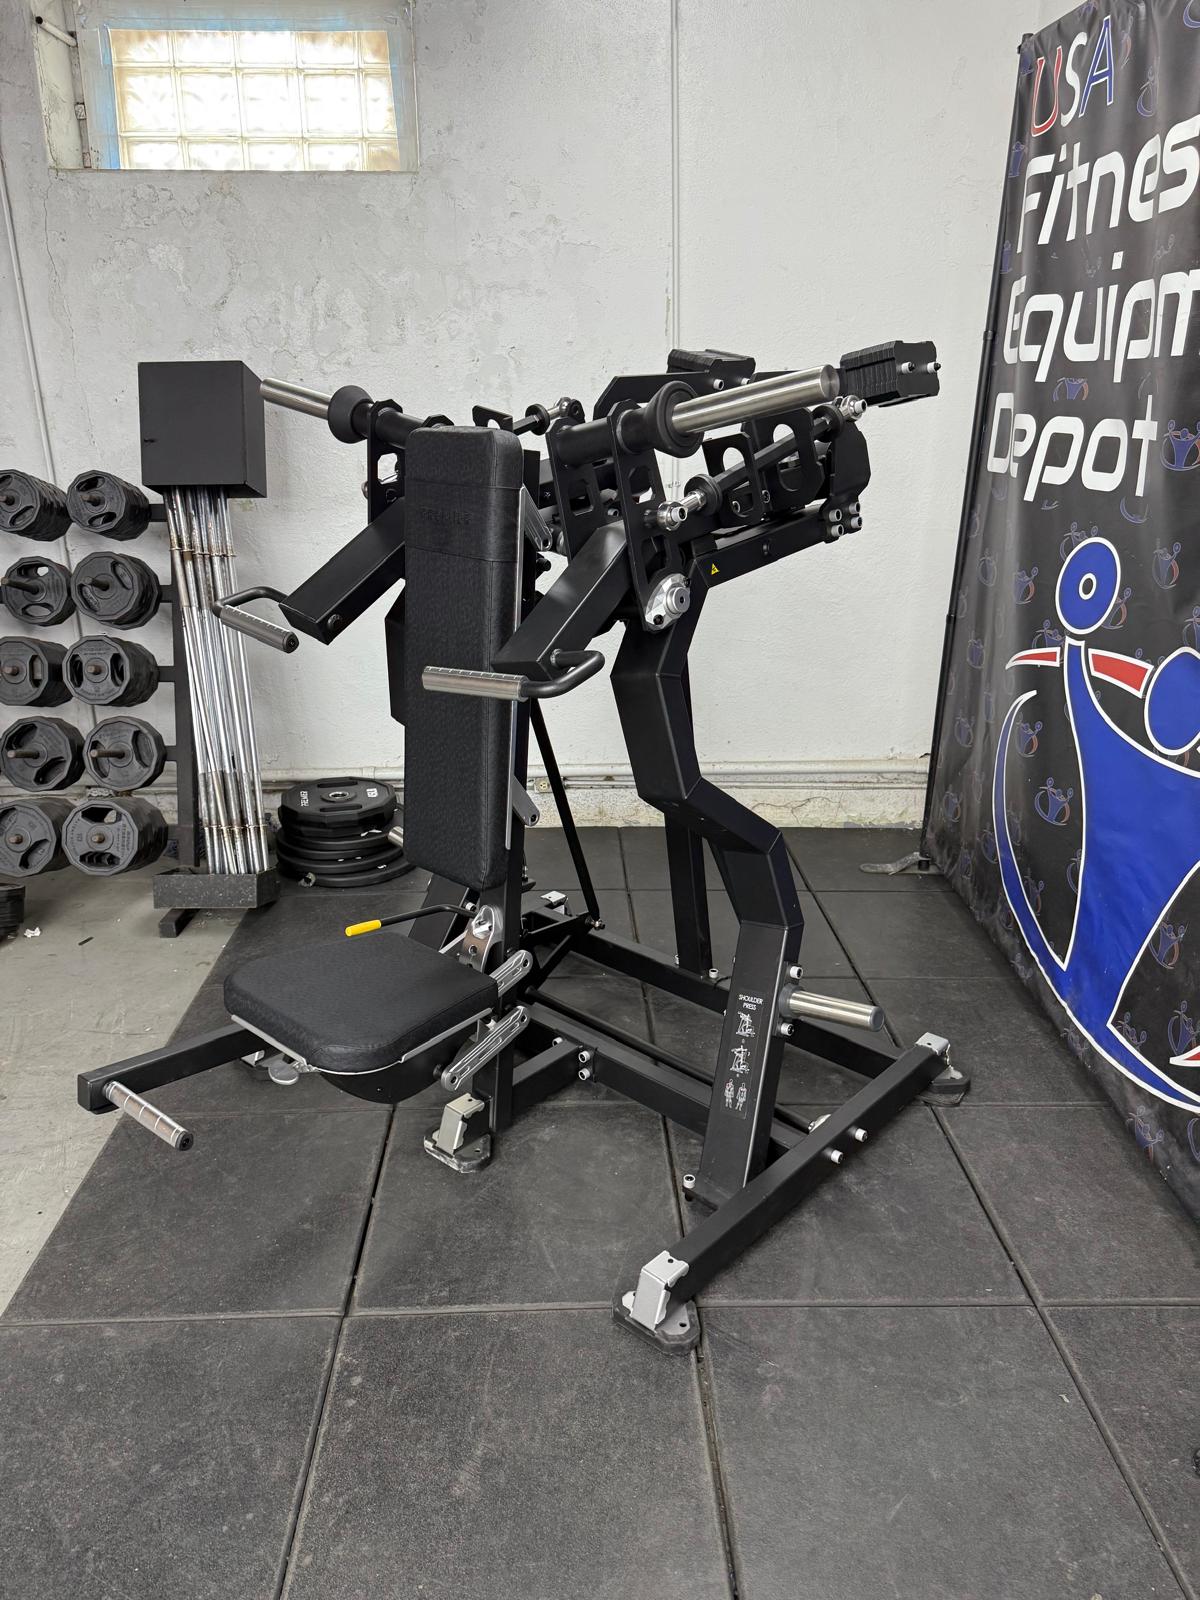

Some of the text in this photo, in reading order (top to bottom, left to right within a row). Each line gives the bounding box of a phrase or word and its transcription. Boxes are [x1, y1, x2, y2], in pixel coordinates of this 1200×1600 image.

[1031, 15, 1114, 136] USA
[986, 393, 1158, 502] Depot
[738, 994, 763, 1005] SHOULDER
[743, 1002, 757, 1010] PRESS
